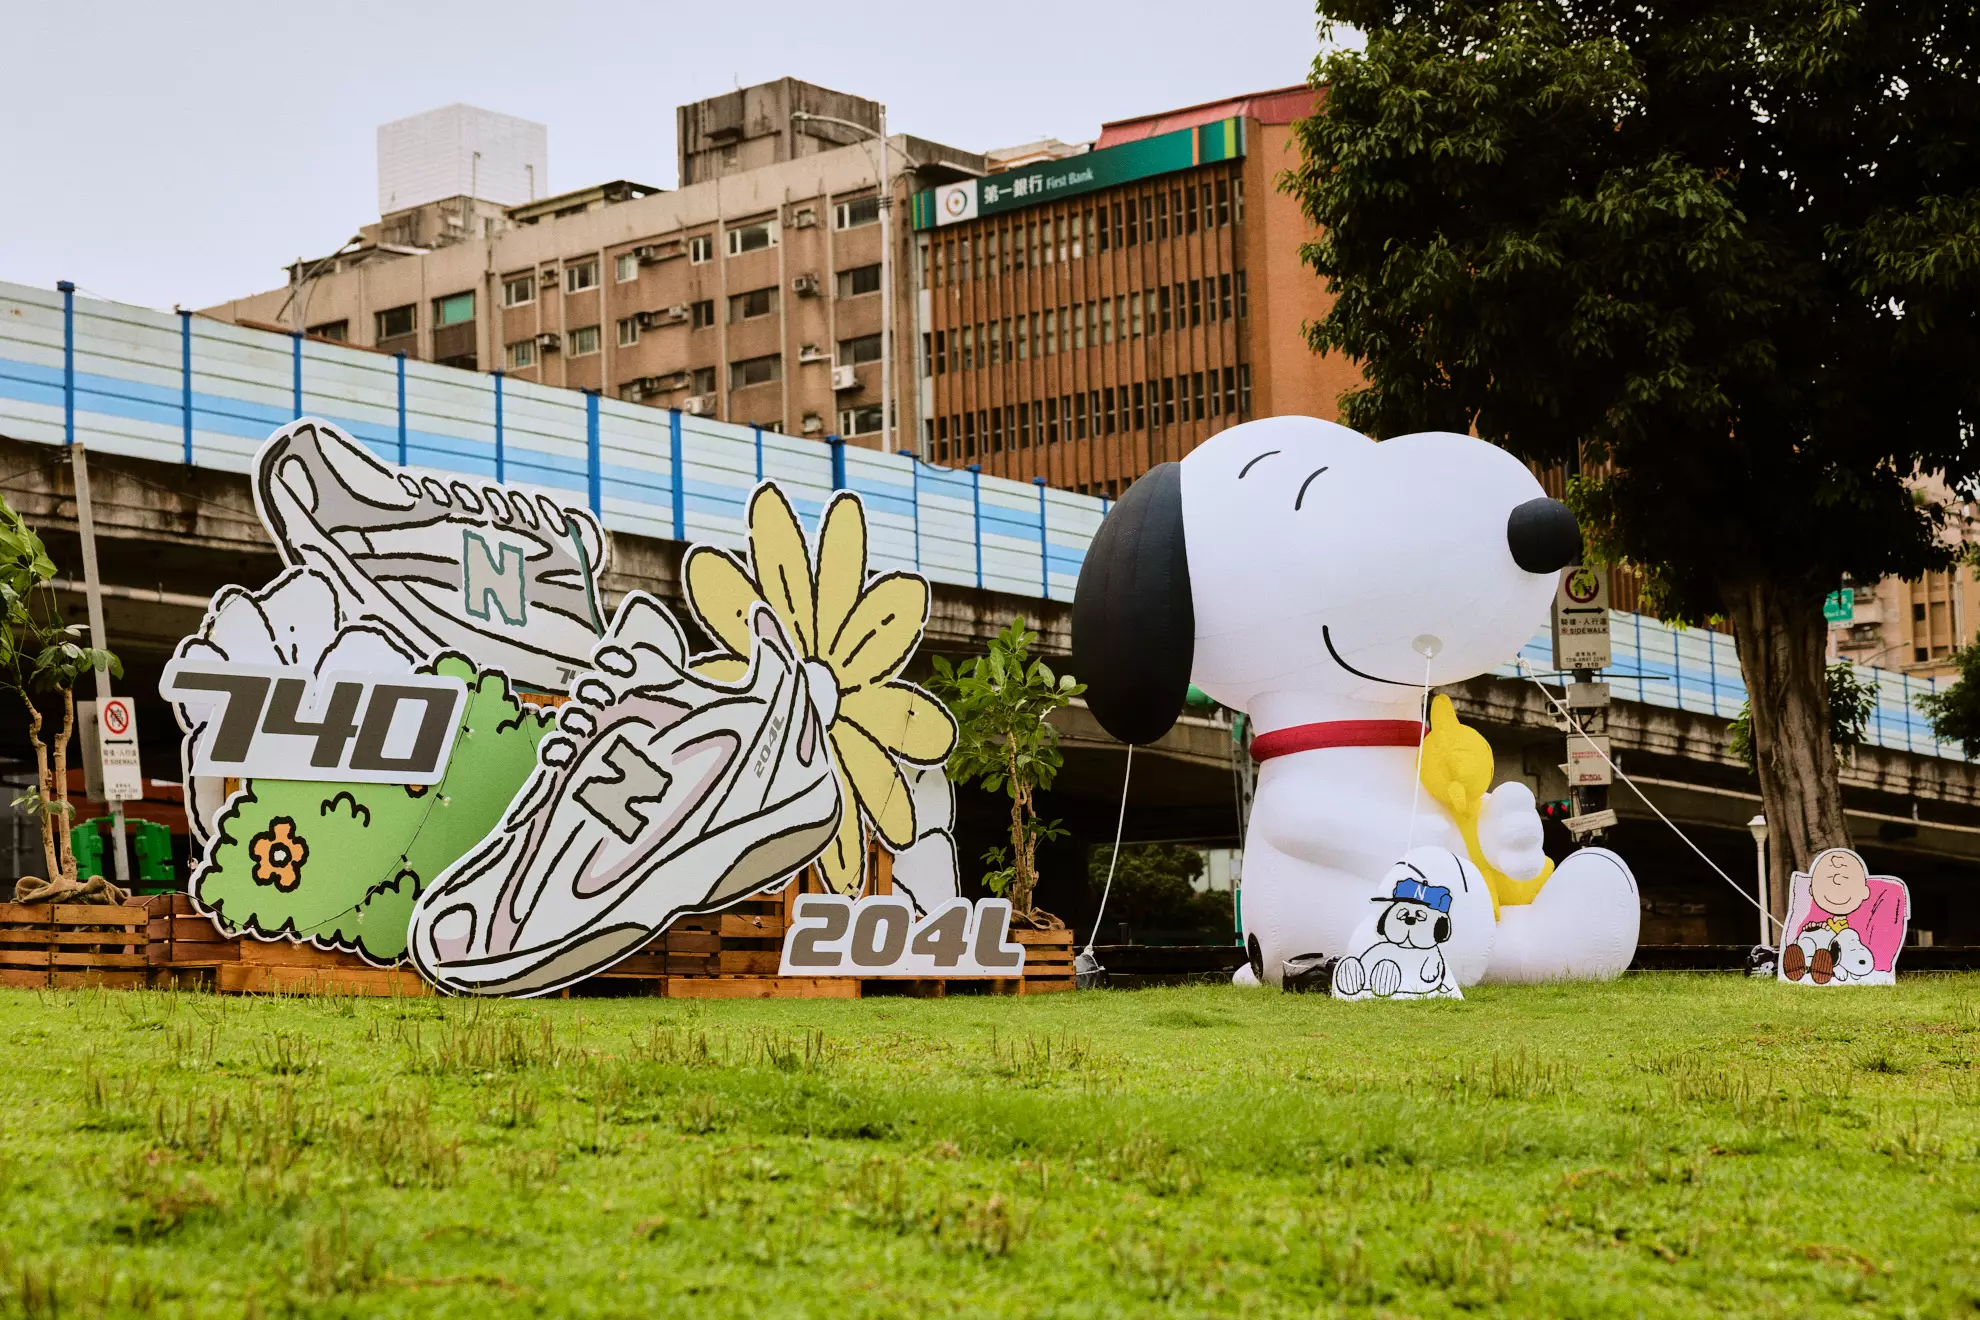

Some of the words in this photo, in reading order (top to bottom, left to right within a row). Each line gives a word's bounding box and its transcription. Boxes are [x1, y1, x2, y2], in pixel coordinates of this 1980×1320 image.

[984, 174, 1043, 204] 第一銀行
[1046, 175, 1067, 190] First
[1068, 167, 1094, 185] Bank
[463, 530, 528, 627] N
[172, 671, 459, 773] 740
[753, 715, 785, 779] 204L
[573, 734, 673, 843] N
[1413, 884, 1427, 900] N
[788, 902, 1021, 968] 204L
